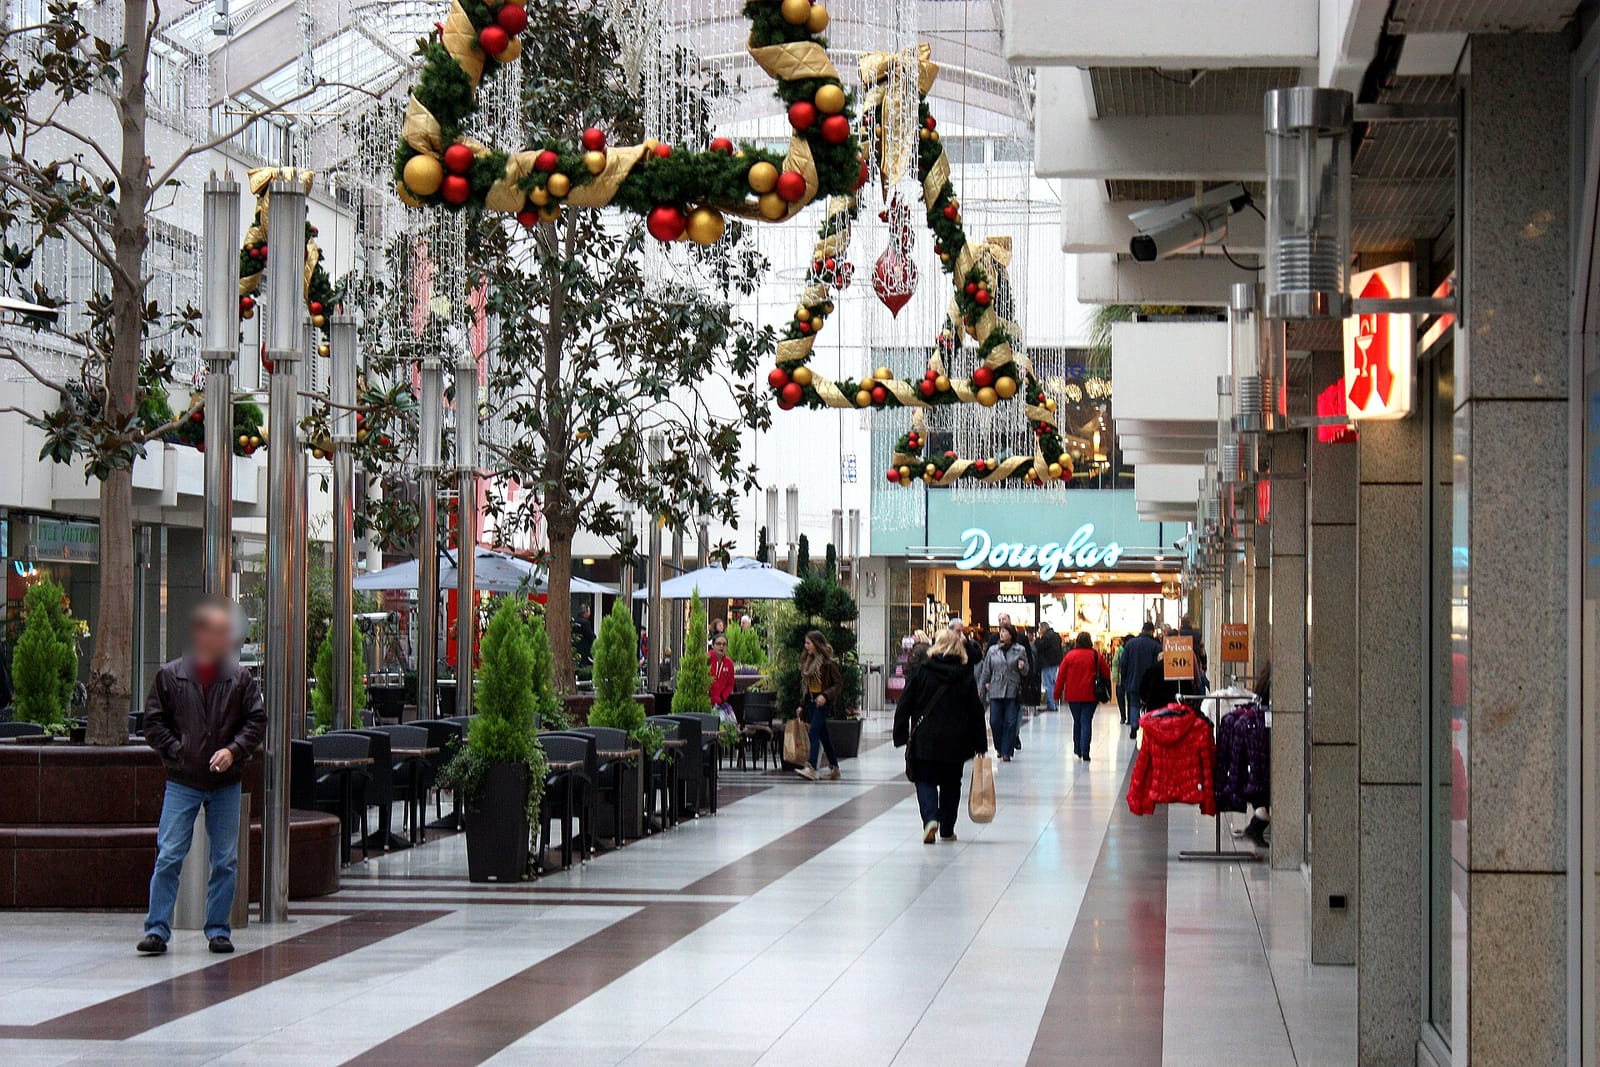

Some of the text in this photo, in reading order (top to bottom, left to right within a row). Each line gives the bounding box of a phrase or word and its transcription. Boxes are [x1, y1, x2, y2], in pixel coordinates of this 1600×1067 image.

[955, 523, 1123, 581] Douglas
[997, 594, 1027, 603] CHANEL
[1165, 641, 1193, 652] Prices
